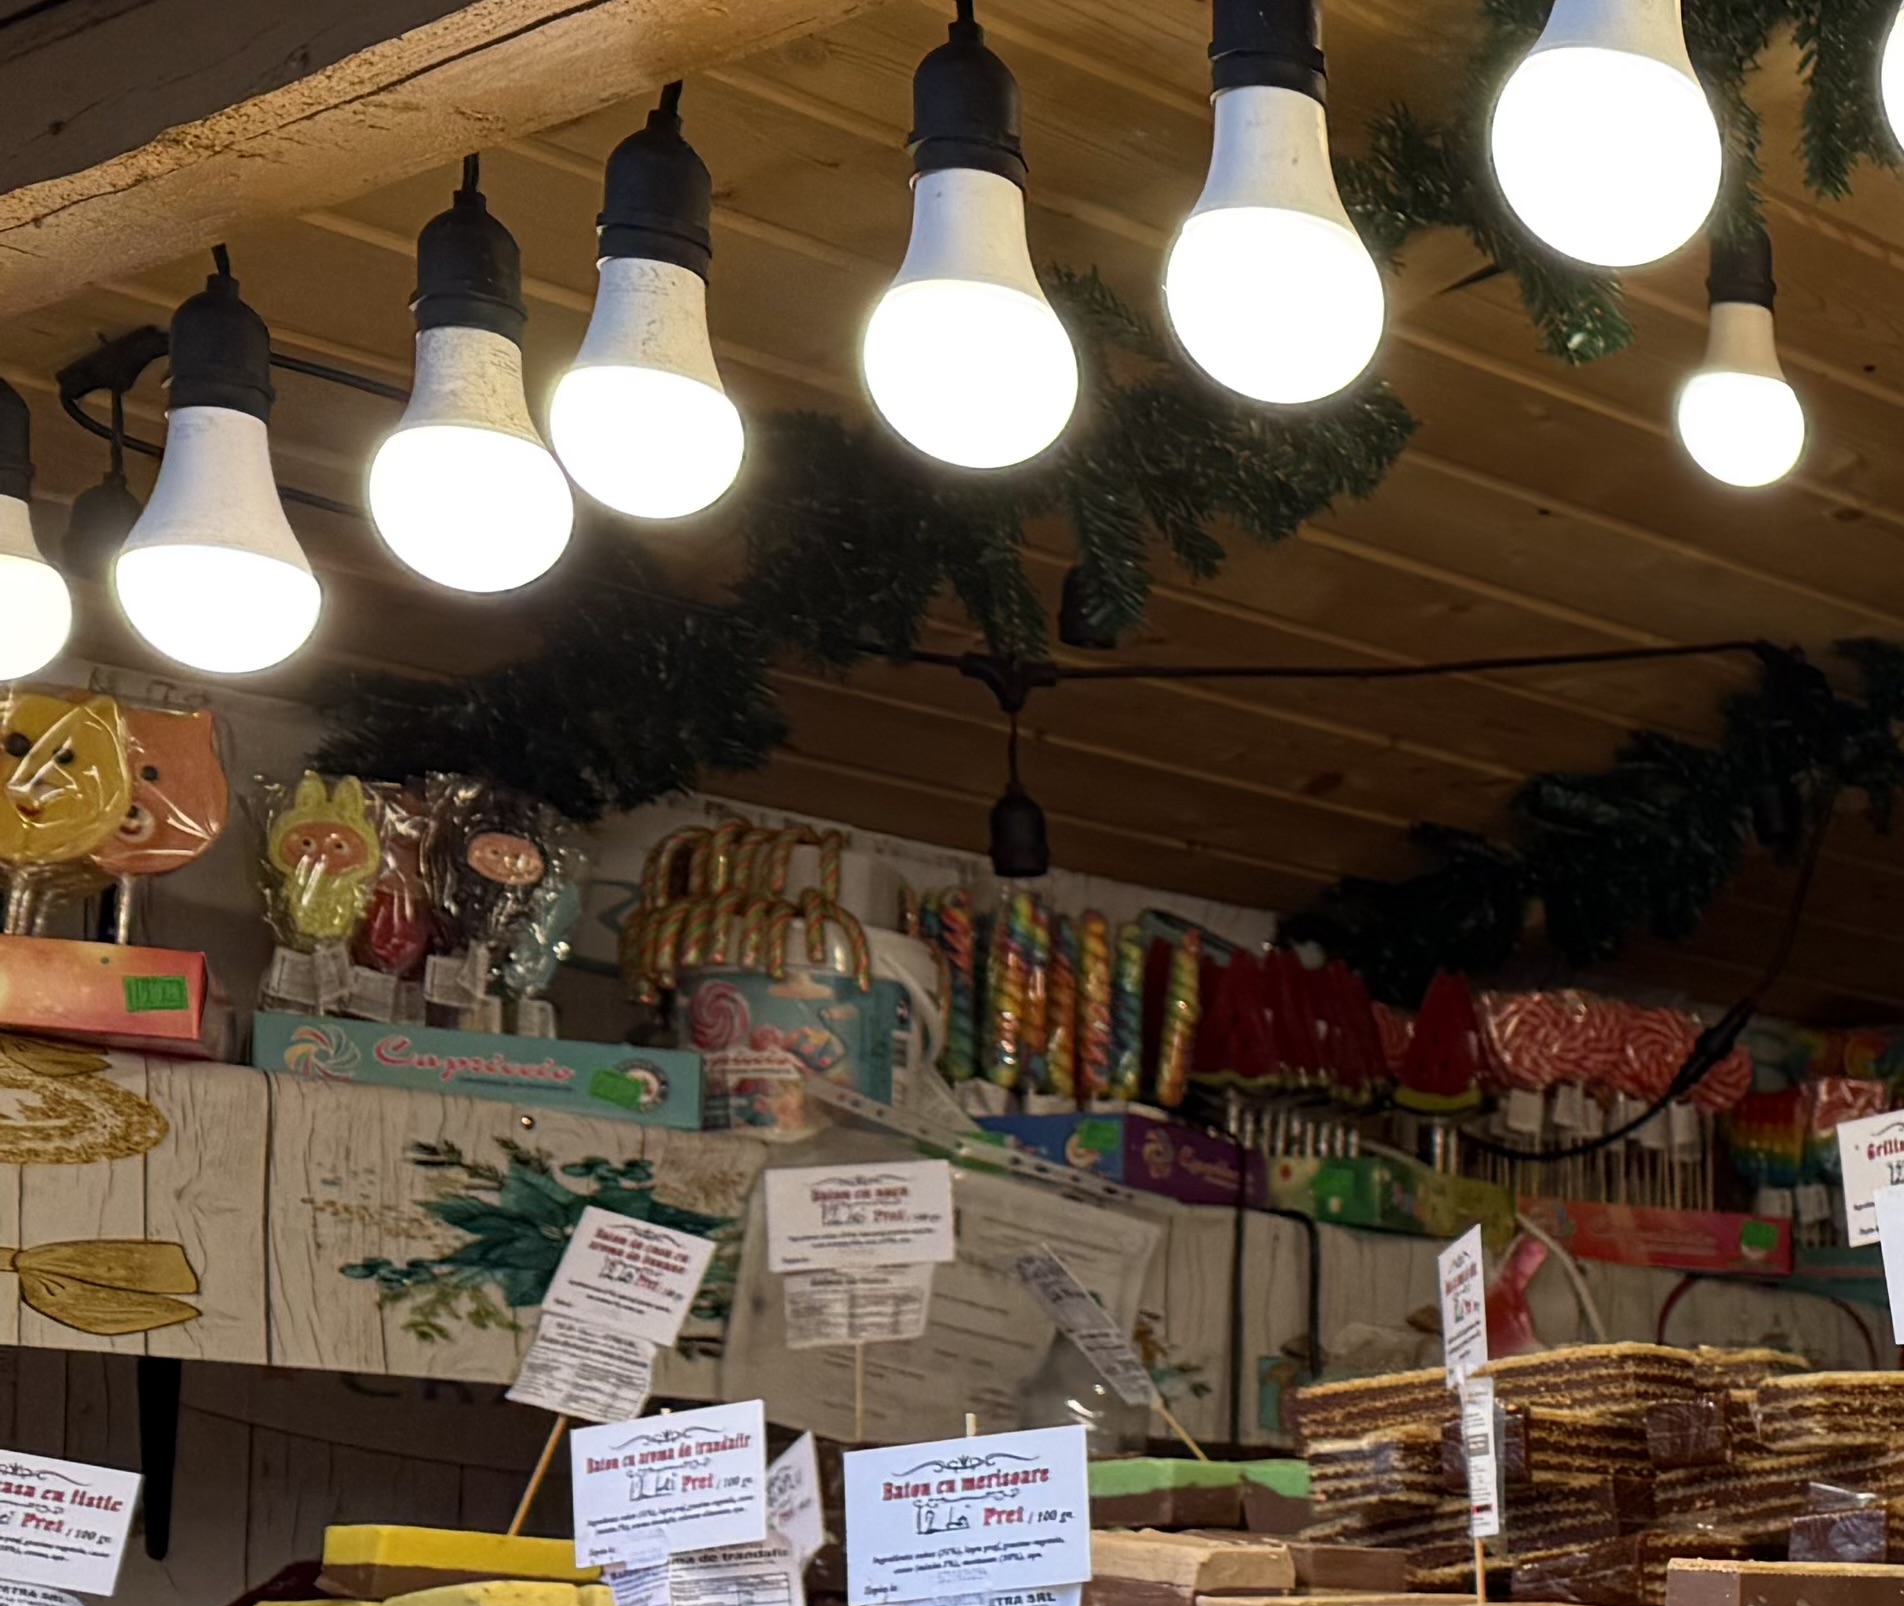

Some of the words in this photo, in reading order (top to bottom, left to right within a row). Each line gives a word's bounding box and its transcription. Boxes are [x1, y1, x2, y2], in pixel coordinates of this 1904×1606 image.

[678, 1443, 692, 1457] de
[681, 1475, 713, 1492] Pret
[882, 1481, 931, 1501] Baton
[936, 1478, 956, 1494] cu
[961, 1467, 1050, 1492] merisoare
[21, 1513, 64, 1534] Pret
[983, 1505, 1025, 1527] Pret
